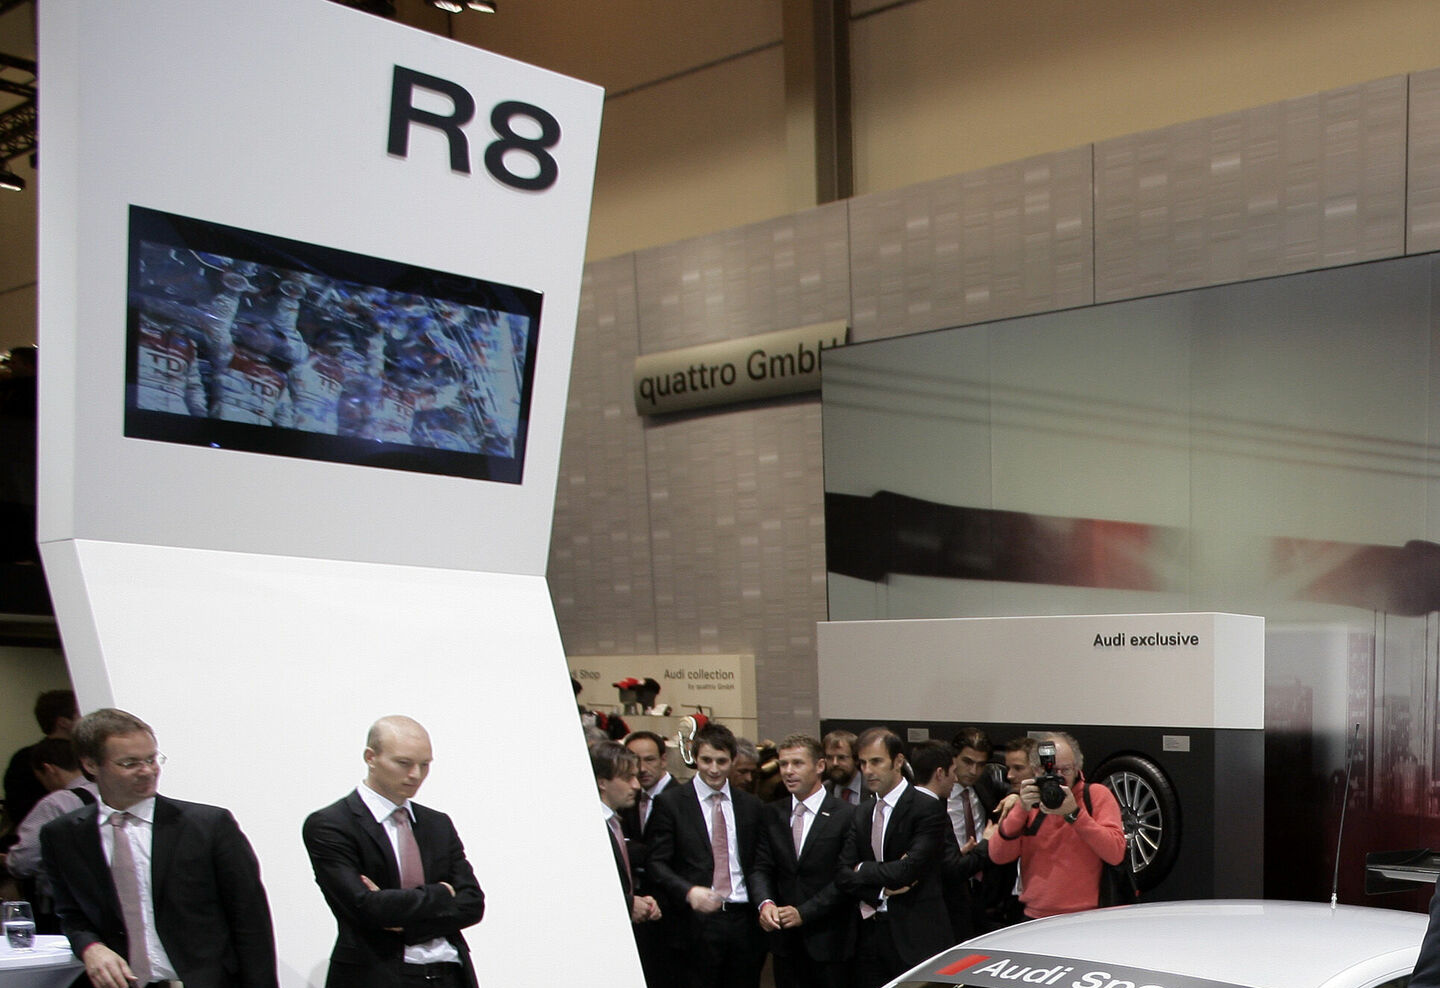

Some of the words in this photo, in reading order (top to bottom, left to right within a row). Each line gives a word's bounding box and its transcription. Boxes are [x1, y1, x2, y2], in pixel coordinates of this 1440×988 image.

[387, 64, 561, 192] R8
[639, 362, 737, 405] quattro
[1093, 633, 1125, 647] Audi
[1130, 632, 1199, 646] exclusive
[664, 668, 685, 680] Audi
[687, 668, 735, 680] collection
[972, 958, 1074, 986] Audi
